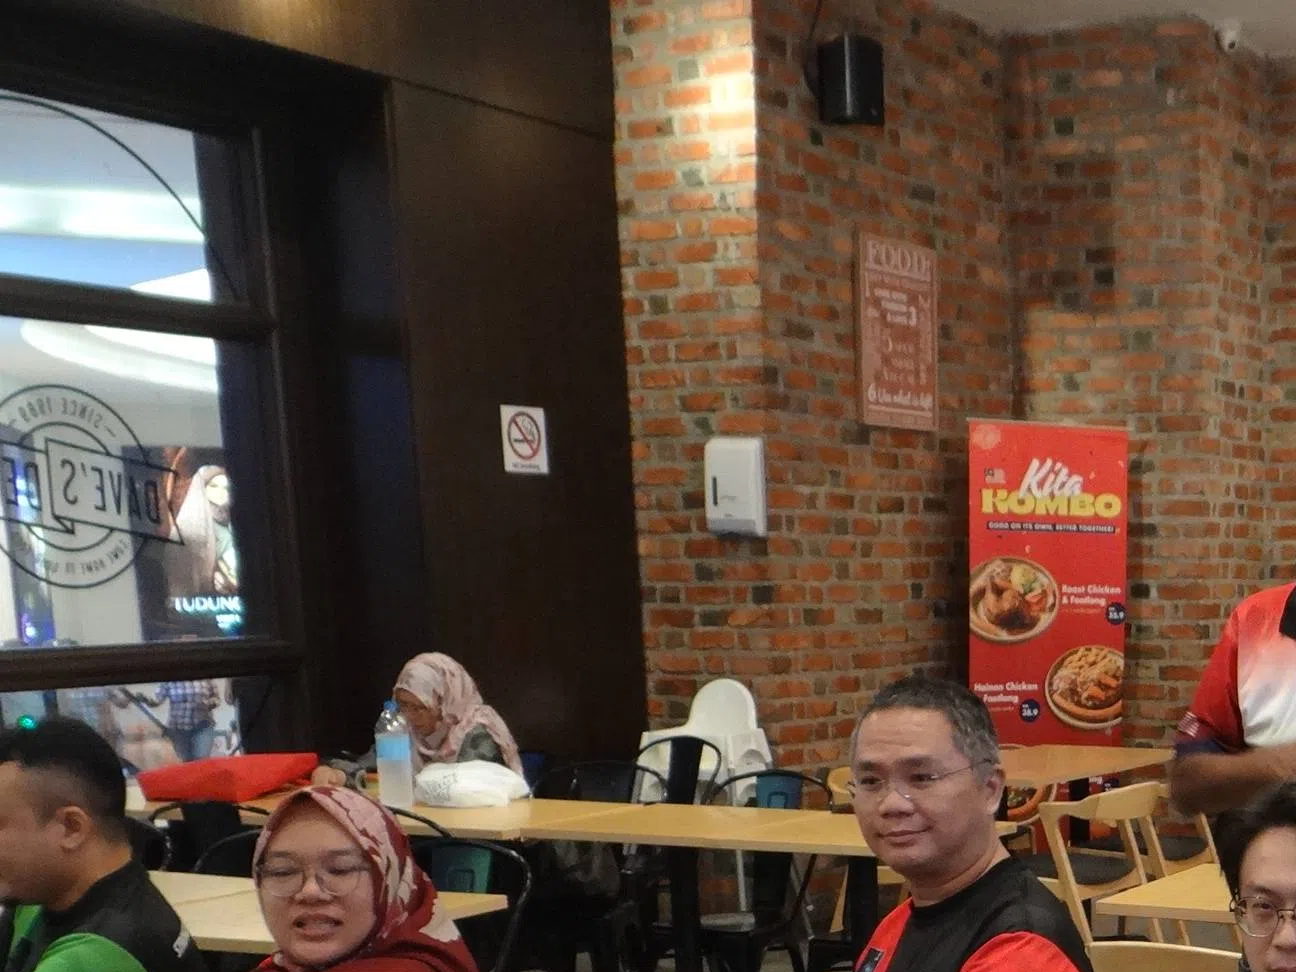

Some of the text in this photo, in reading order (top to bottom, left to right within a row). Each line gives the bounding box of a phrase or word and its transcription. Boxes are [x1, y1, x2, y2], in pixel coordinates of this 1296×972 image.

[980, 487, 1122, 519] KOMBO
[1087, 584, 1121, 595] Chicken
[1005, 681, 1038, 691] Chicken
